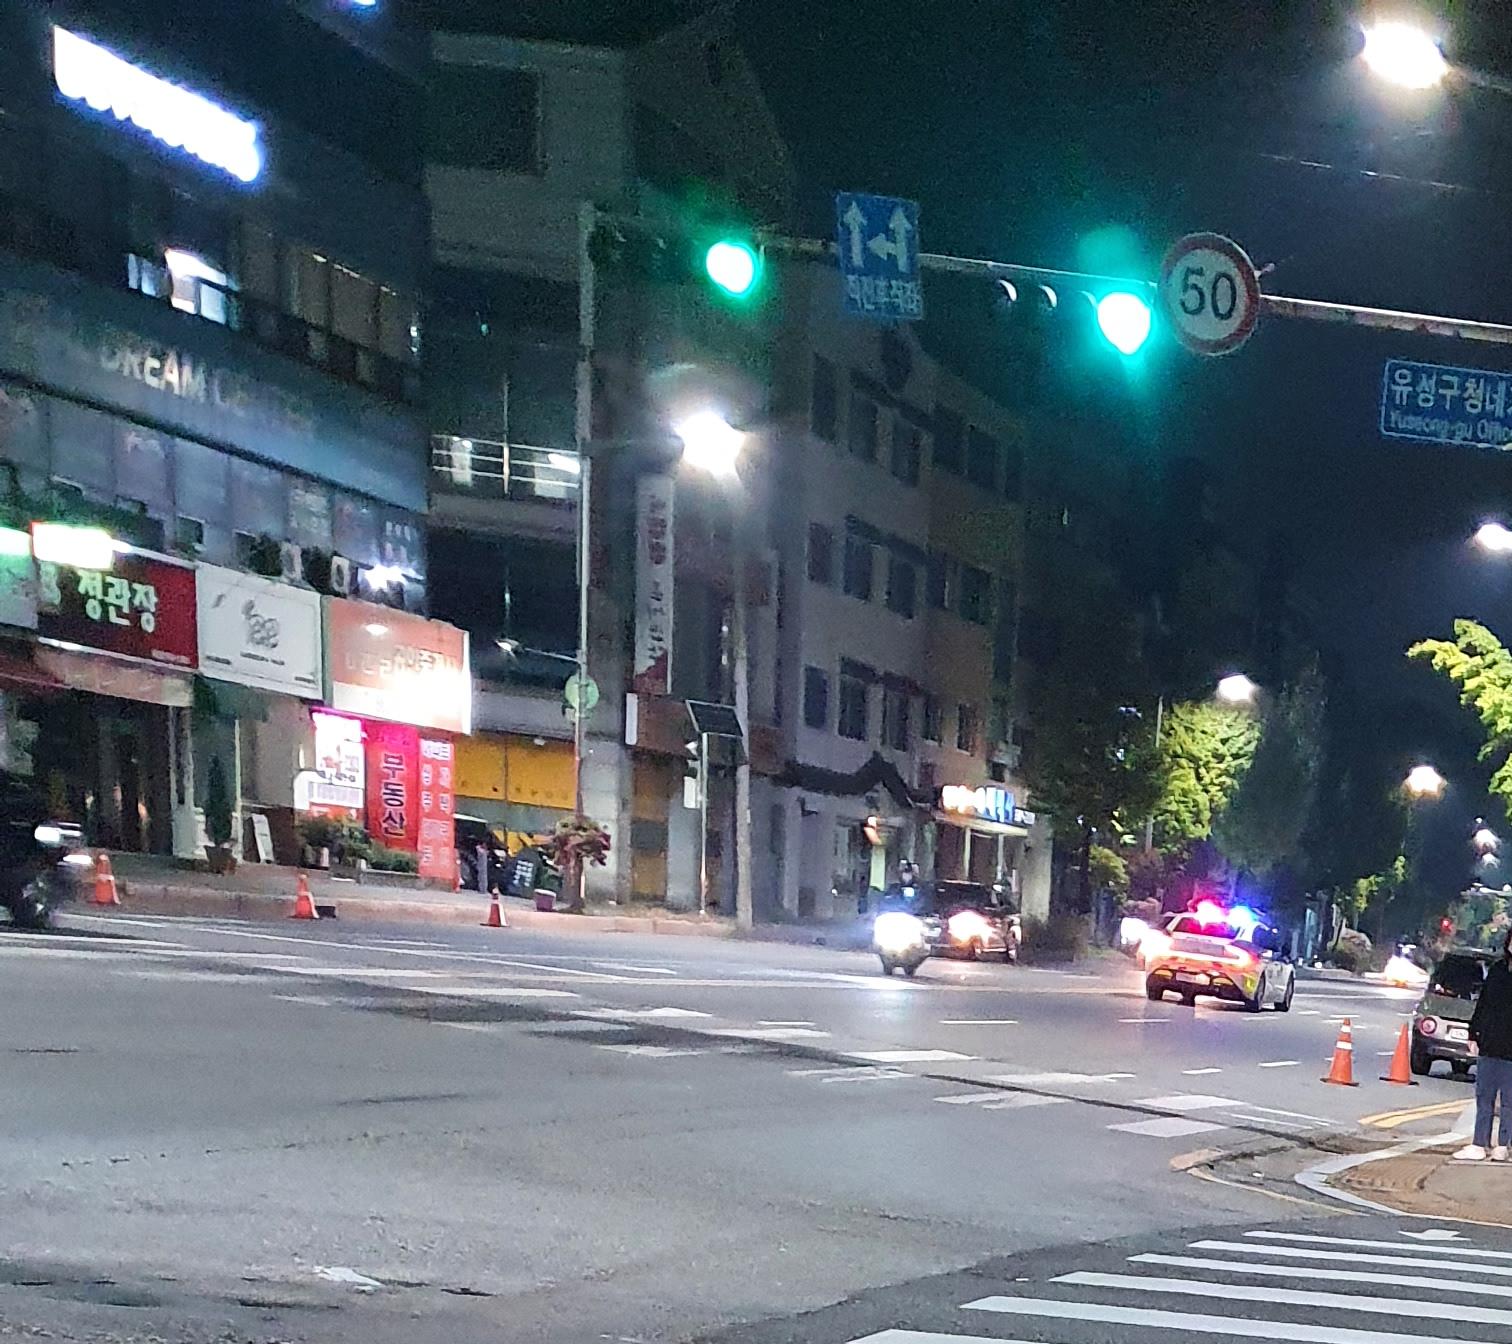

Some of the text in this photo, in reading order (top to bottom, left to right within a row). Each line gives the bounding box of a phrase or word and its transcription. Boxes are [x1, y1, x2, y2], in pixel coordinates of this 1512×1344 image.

[1180, 265, 1237, 321] 50
[77, 568, 158, 634] 정관장
[382, 752, 405, 837] 부동산
